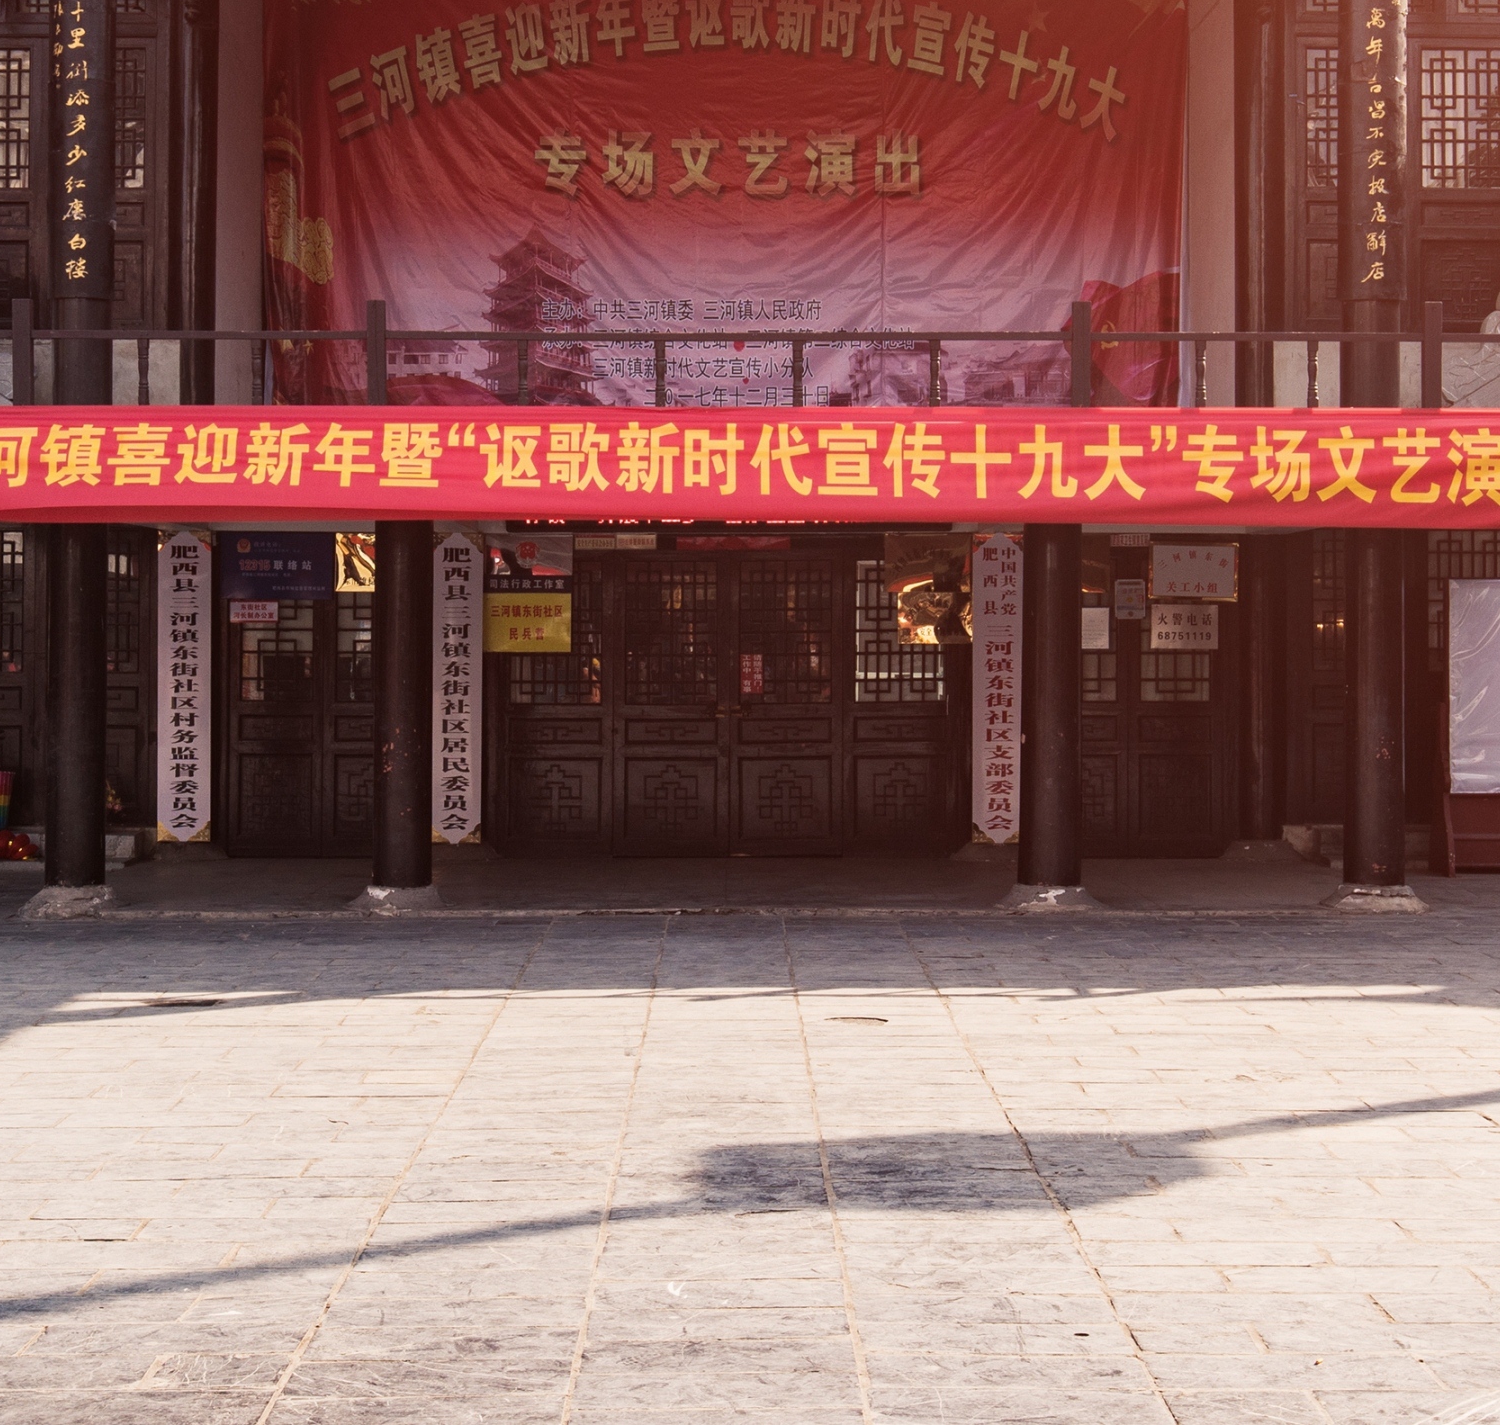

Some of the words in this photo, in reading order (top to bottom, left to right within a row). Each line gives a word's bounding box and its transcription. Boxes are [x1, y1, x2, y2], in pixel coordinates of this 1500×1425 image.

[534, 128, 922, 197] 专场文艺演出
[703, 299, 822, 321] 三河镇人民政府
[1157, 549, 1230, 570] 三河镇东街
[489, 578, 565, 590] 司法行政工作室
[982, 547, 999, 616] 肥西县
[1000, 547, 1018, 616] 中国共产党
[1165, 581, 1219, 594] 关工小组
[233, 611, 275, 620] 河长制办公室
[240, 603, 268, 611] 东街社区
[490, 605, 563, 618] 三河镇东街社区
[1157, 612, 1213, 626] 火警电话
[509, 627, 545, 641] 民兵营
[1157, 631, 1212, 641] 68751119
[168, 544, 201, 831] 肥西县三河镇东街社区村务监督委员会
[440, 545, 472, 833] 肥西县三河镇东街社区居民委员会
[984, 623, 1016, 833] 三河镇东街社区支部委员会
